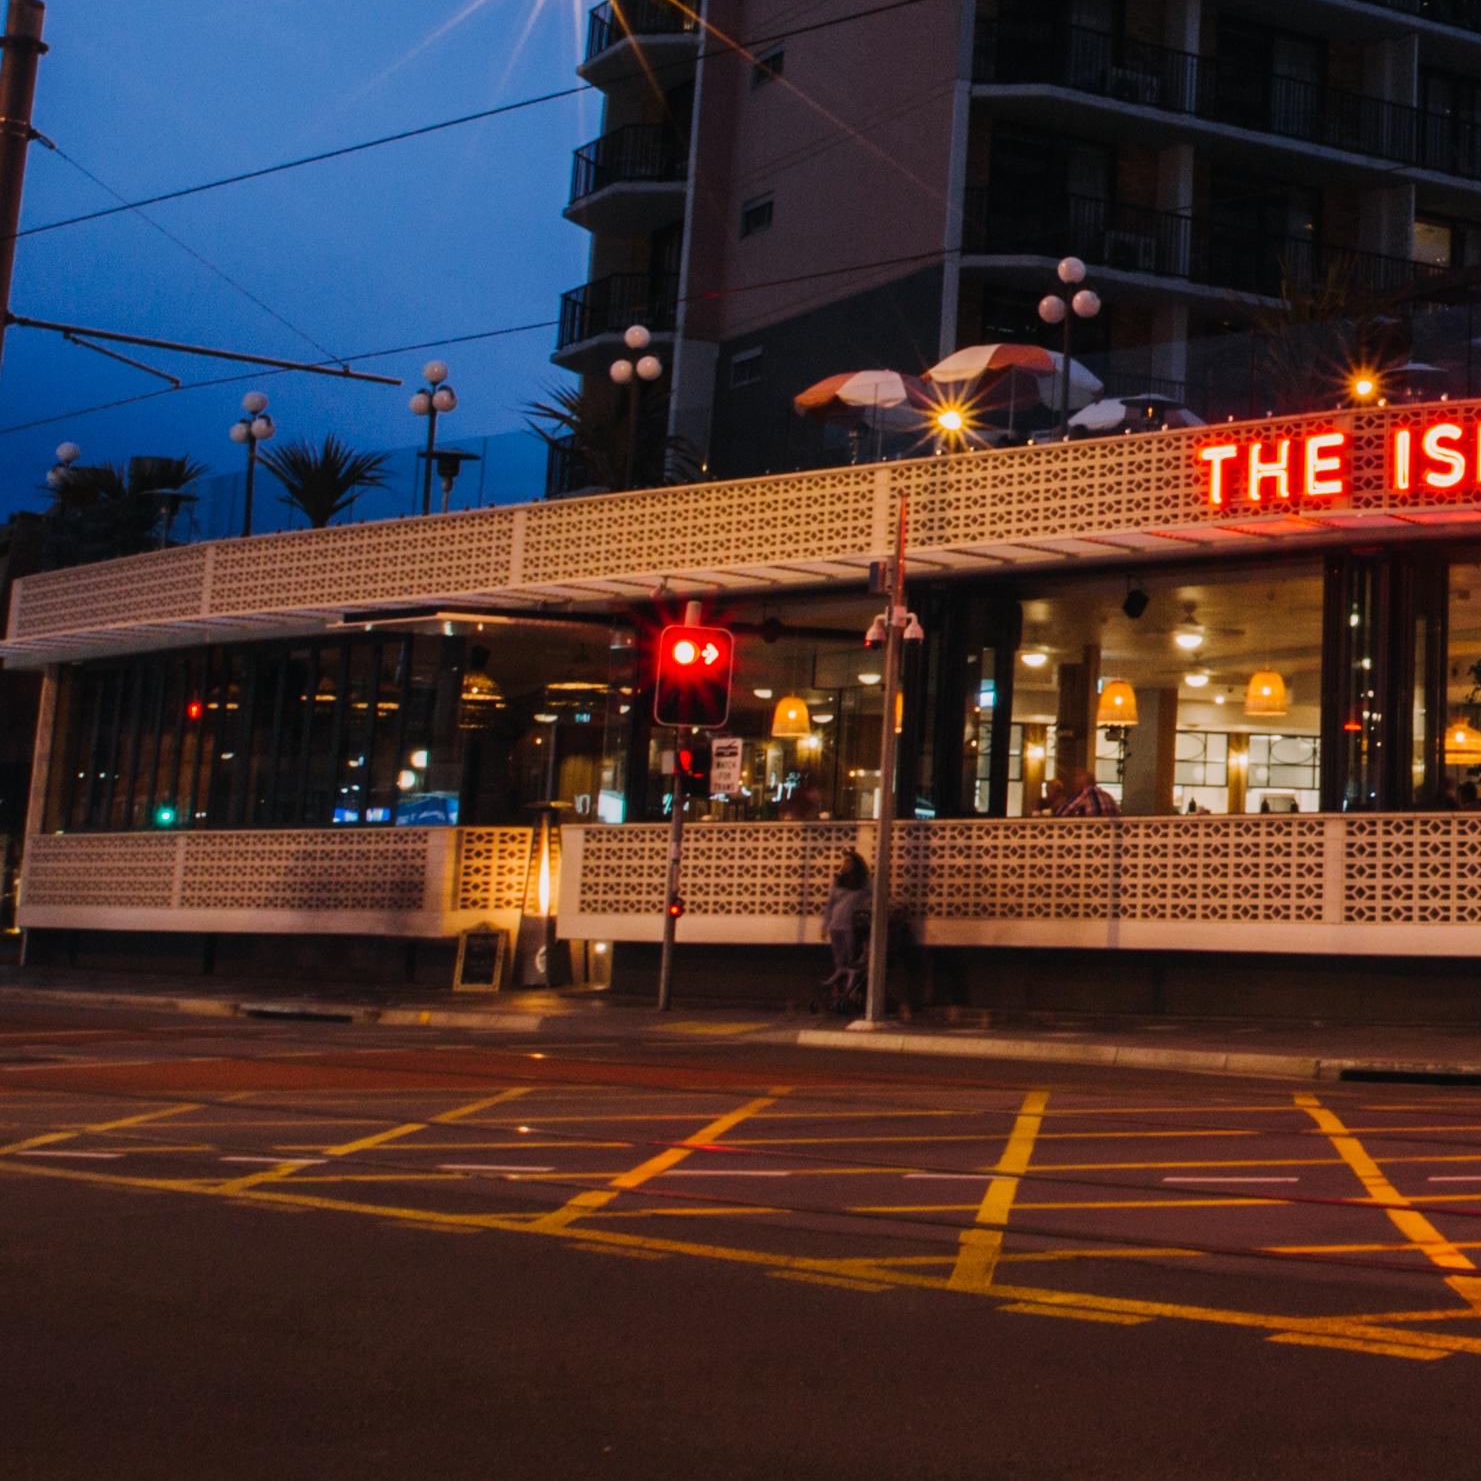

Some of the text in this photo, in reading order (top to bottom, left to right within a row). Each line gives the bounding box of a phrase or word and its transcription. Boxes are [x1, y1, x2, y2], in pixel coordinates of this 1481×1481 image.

[1200, 432, 1345, 504] THE
[716, 761, 737, 769] WATCH
[719, 772, 732, 780] FOR
[714, 782, 736, 791] TRAMS
